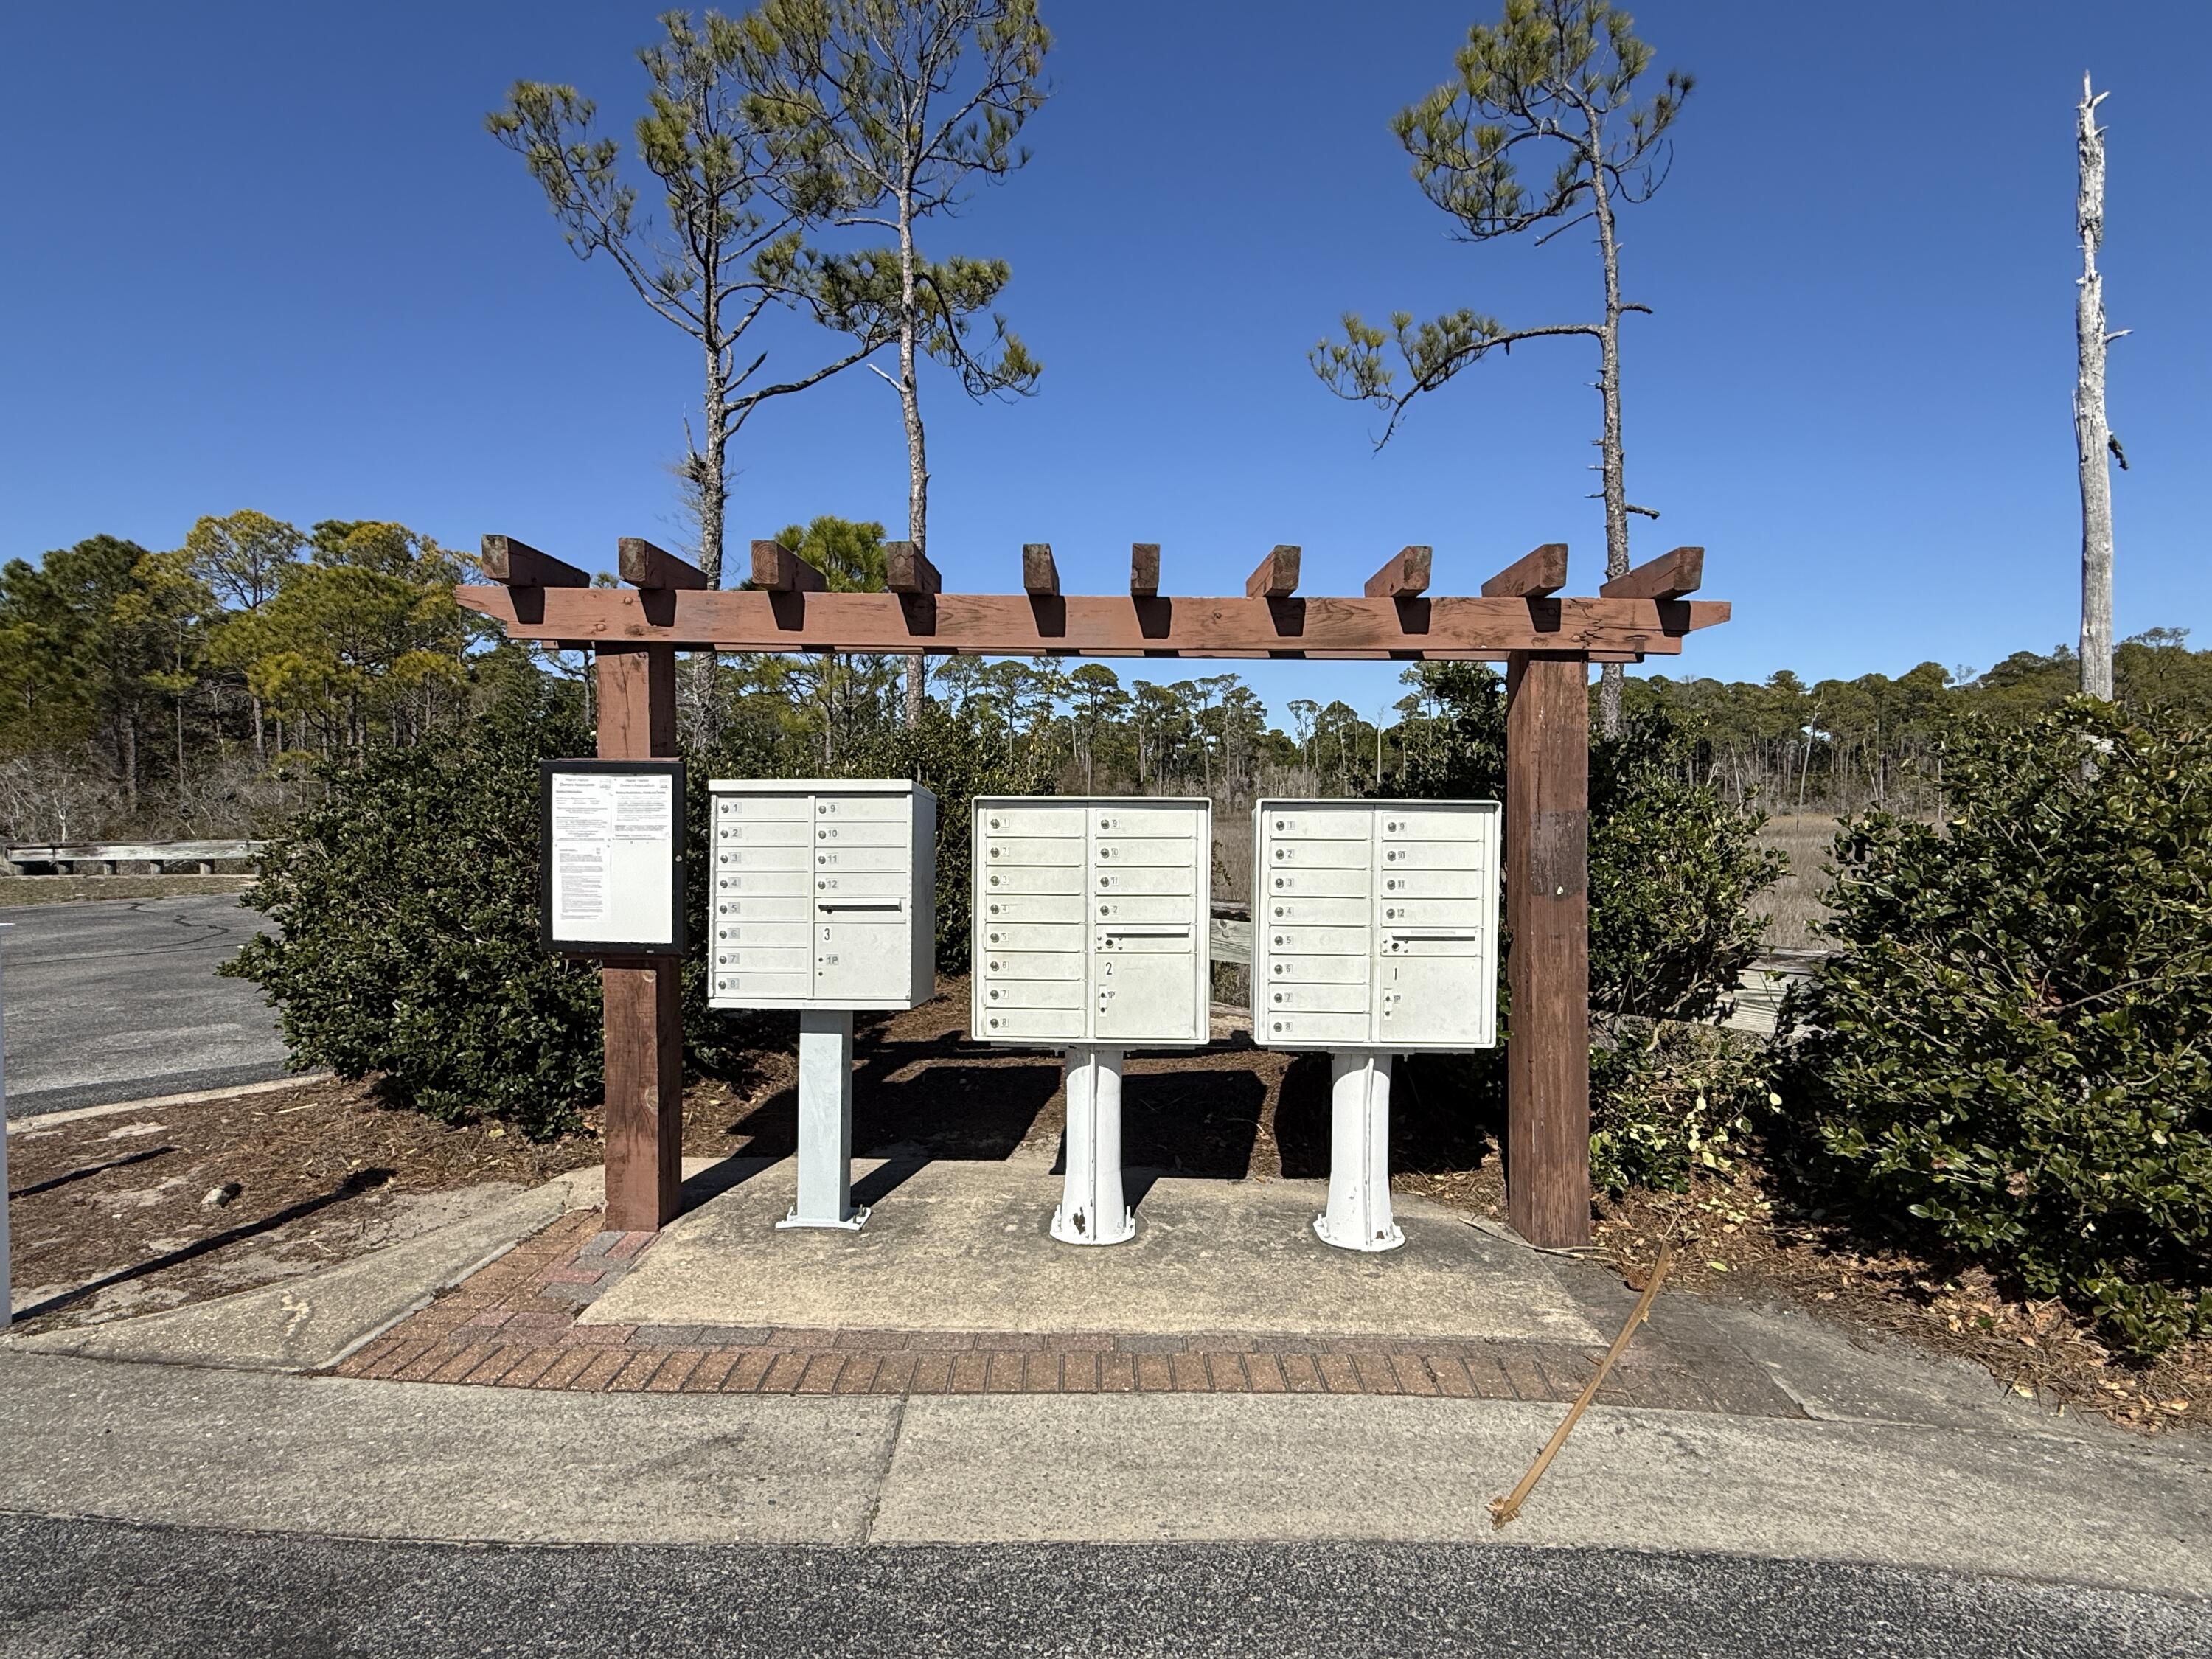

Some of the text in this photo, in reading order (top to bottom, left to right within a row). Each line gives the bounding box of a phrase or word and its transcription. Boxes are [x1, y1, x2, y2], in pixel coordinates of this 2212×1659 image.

[828, 830, 838, 838] 10
[1111, 848, 1119, 856] 10
[824, 928, 830, 940] 3
[1105, 962, 1113, 975] 2
